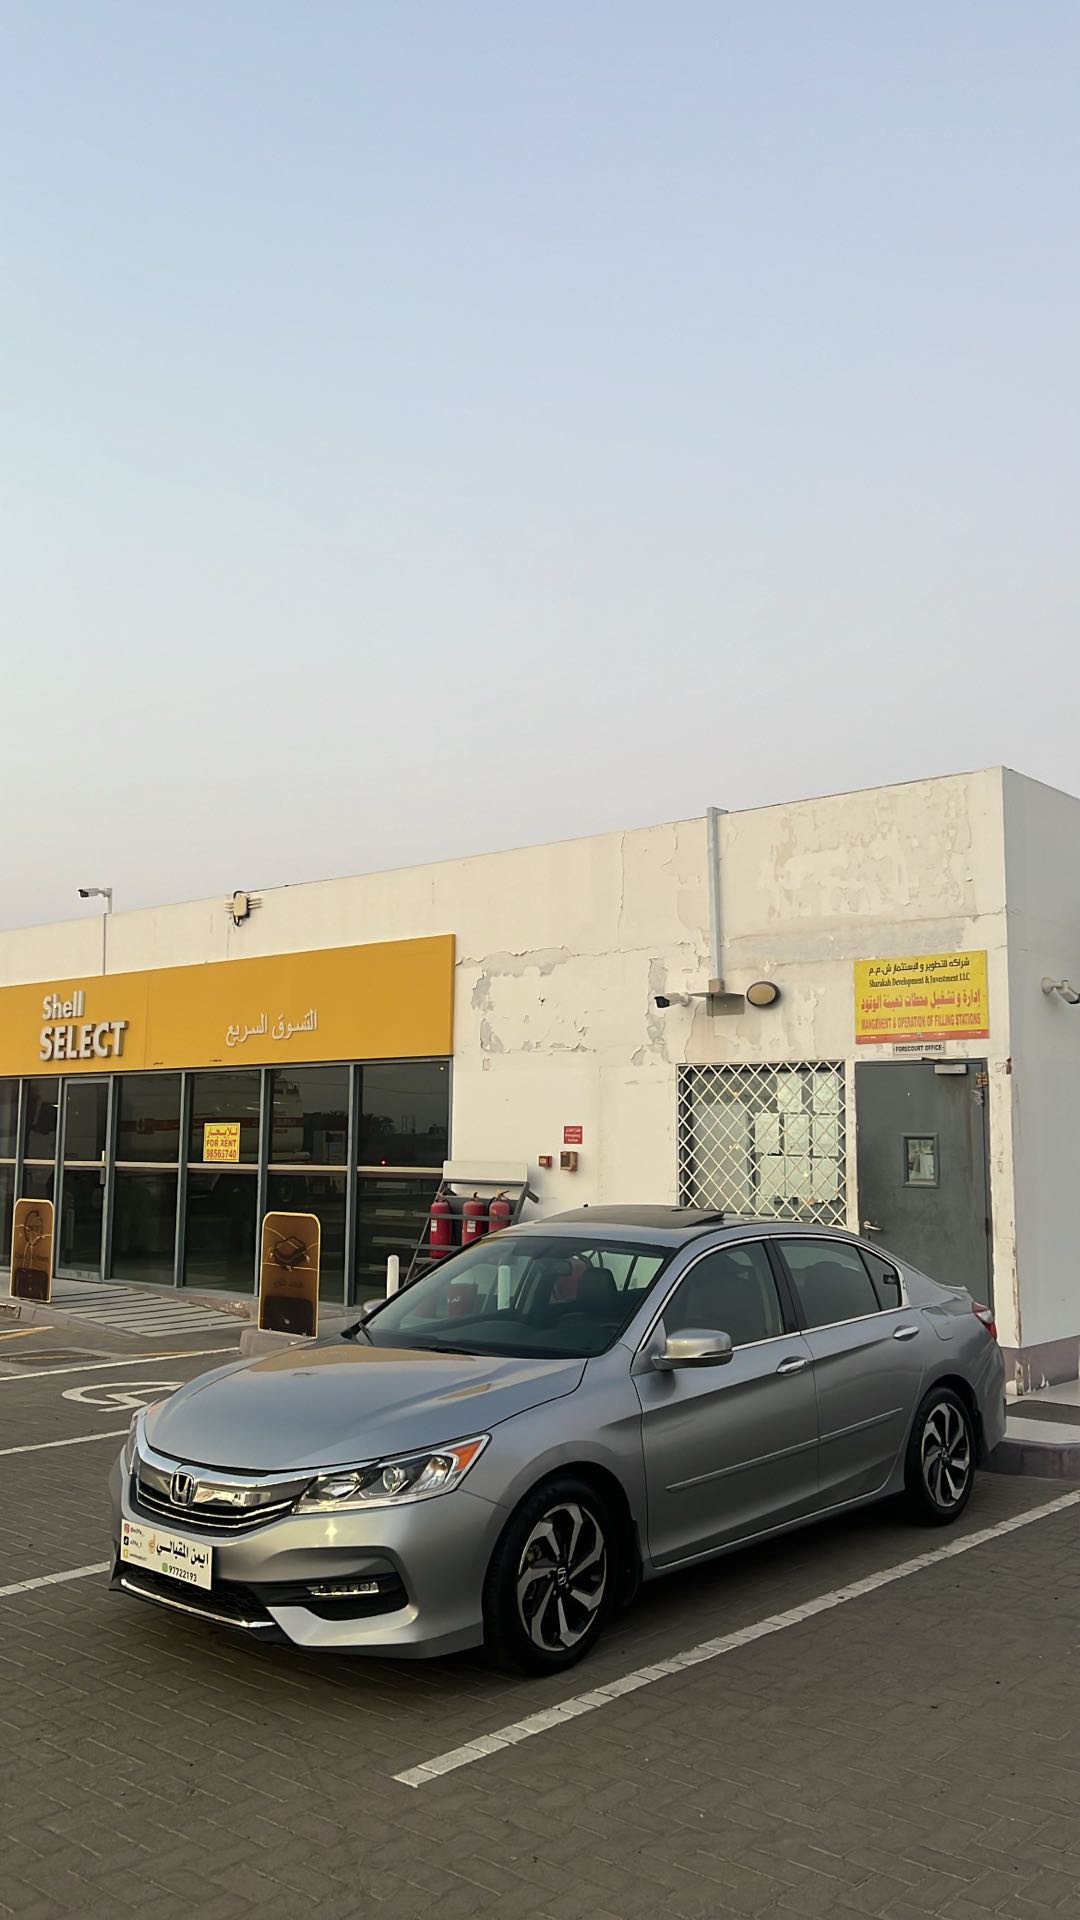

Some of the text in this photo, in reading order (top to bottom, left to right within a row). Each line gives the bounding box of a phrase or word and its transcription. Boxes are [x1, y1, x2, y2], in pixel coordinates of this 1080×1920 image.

[869, 979, 891, 988] Sharakah
[892, 977, 924, 987] Development
[930, 974, 959, 984] Investment
[959, 973, 970, 981] LLC
[42, 990, 84, 1020] Shell
[225, 1008, 318, 1047] التسوق السريع
[897, 1016, 926, 1029] OPERATION
[927, 1015, 934, 1027] OF
[934, 1014, 955, 1027] FILLING
[955, 1012, 981, 1026] STATIONS
[39, 1020, 128, 1061] SELECT
[895, 1044, 942, 1053] FORECOURT OFFICE
[206, 1139, 237, 1148] FOR RENT
[168, 1565, 198, 1583] 97722193
